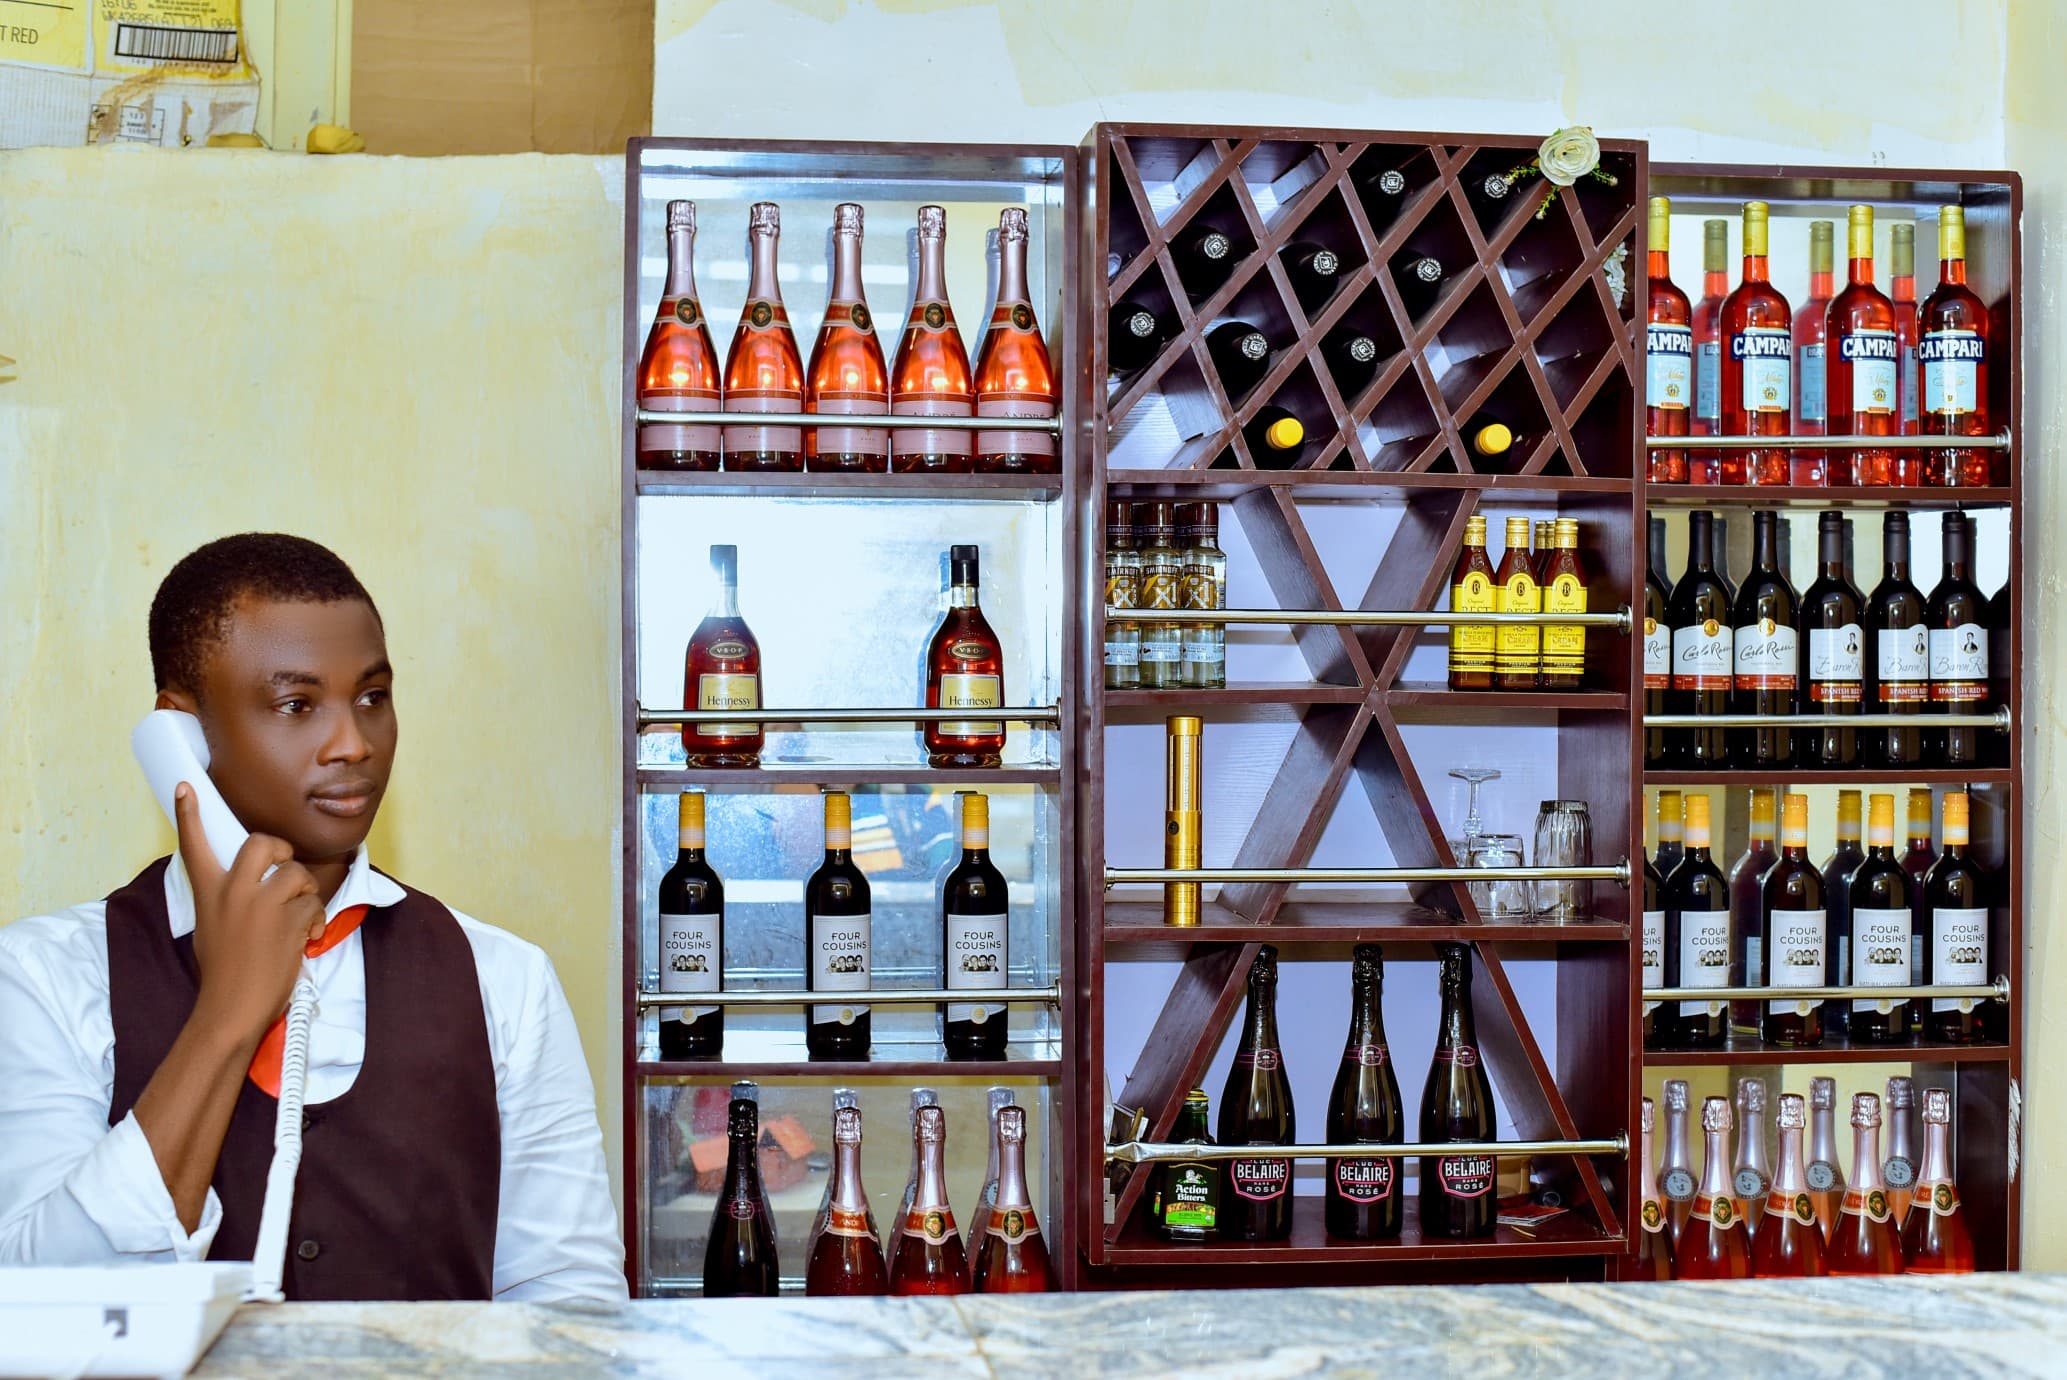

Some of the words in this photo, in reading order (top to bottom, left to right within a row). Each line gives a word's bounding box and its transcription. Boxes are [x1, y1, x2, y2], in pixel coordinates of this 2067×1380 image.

[11, 26, 39, 44] RED
[1919, 338, 1983, 359] CAMPARI
[707, 695, 752, 707] Hennessy
[949, 695, 993, 707] Hennessy
[1701, 927, 1726, 936] FOUR
[1789, 927, 1818, 936] FOUR
[1870, 925, 1900, 934] FOUR
[1951, 925, 1980, 933] FOUR
[672, 931, 704, 940] FOUR
[831, 932, 861, 941] FOUR
[963, 931, 994, 940] FOUR
[1861, 934, 1907, 943] COUSINS
[1942, 934, 1985, 943] COUSINS
[665, 941, 712, 949] COUSINS
[1780, 936, 1823, 945] COUSINS
[822, 941, 867, 951] COUSINS
[955, 941, 1002, 950] COUSINS
[1237, 1163, 1285, 1179] BELAIRE
[1445, 1159, 1491, 1177] BELAIRE
[1340, 1166, 1389, 1182] BELAIRE
[1175, 1184, 1208, 1195] Action
[1247, 1185, 1276, 1193] ROSÉ
[1456, 1182, 1484, 1190] ROSÉ
[1177, 1193, 1206, 1201] Bitters
